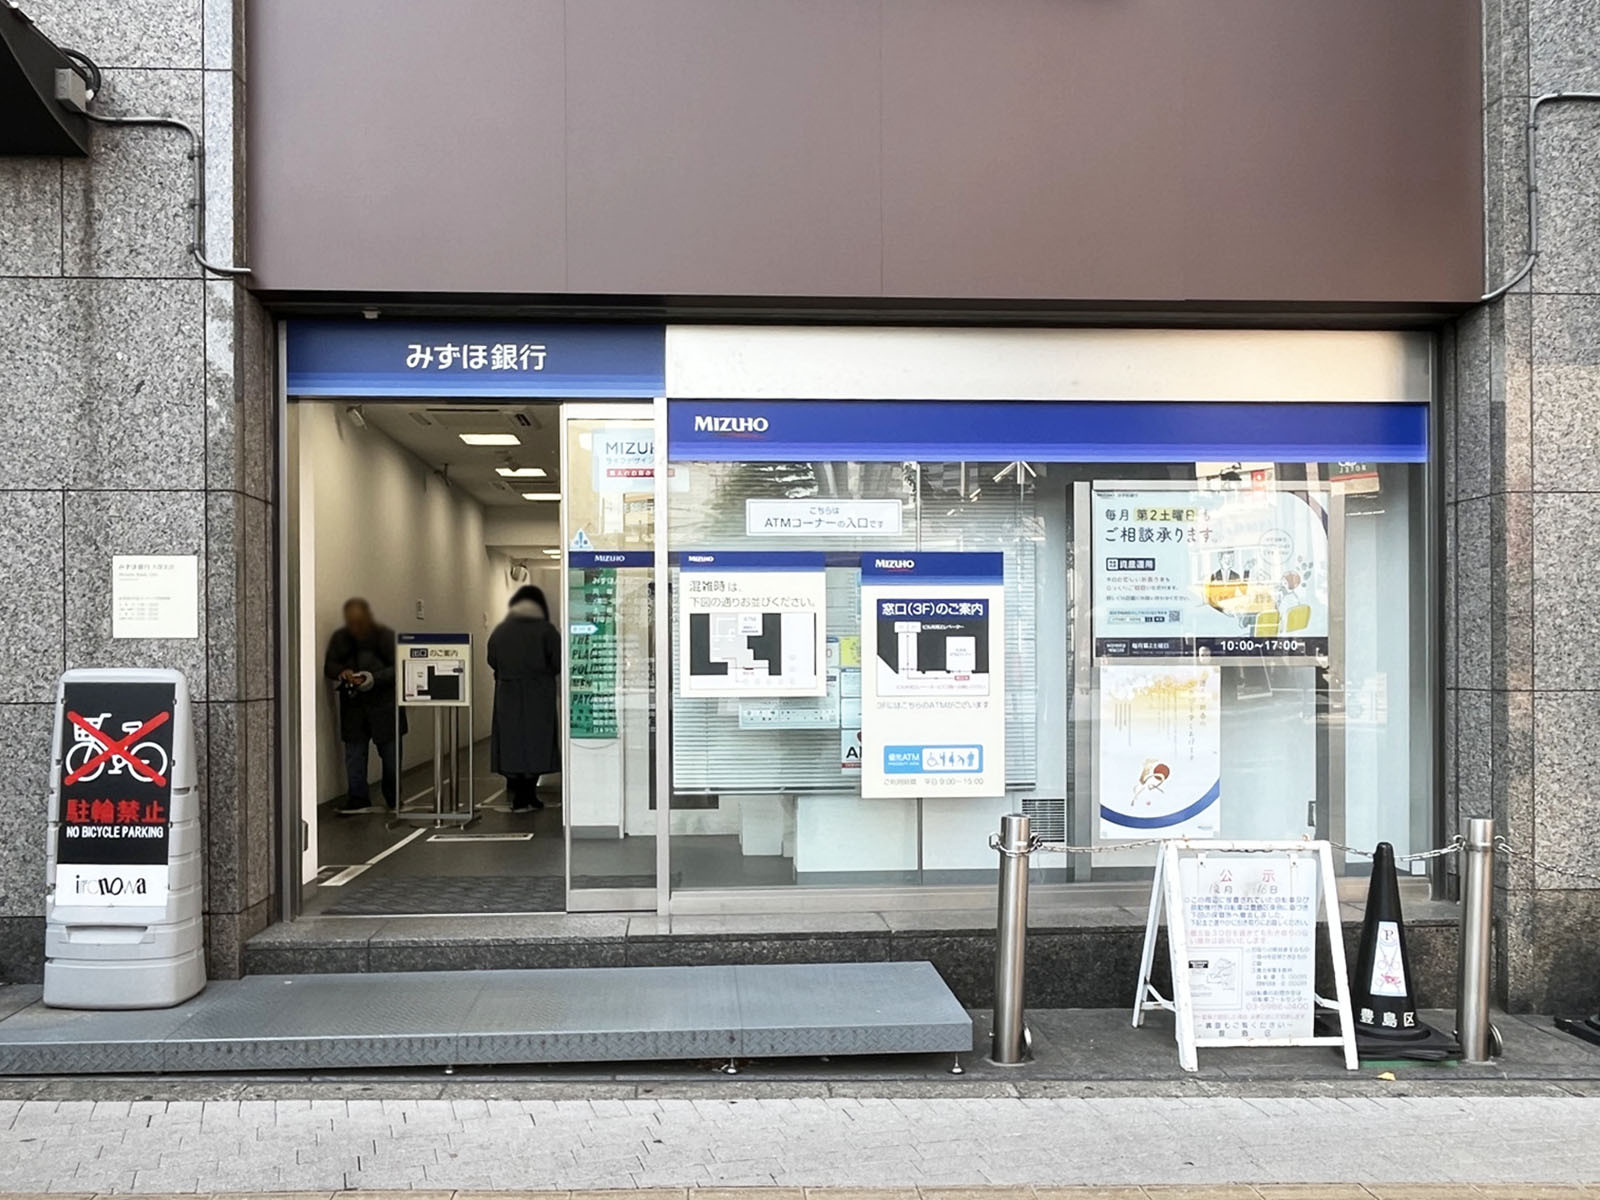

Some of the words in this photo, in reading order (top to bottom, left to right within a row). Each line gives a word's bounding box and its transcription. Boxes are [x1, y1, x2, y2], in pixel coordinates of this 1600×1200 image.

[406, 344, 547, 371] みずほ銀行
[694, 416, 769, 432] MIZUHO
[809, 506, 839, 515] こちらは
[1105, 508, 1129, 522] 毎月
[1136, 508, 1196, 522] 第2土曜日
[764, 517, 884, 528] ATMコーナーの入口です
[875, 559, 915, 569] MIZUHO
[882, 603, 984, 616] 窓口(3F)のご案内
[66, 799, 166, 823] 駐輪禁止
[66, 826, 79, 838] NO
[81, 826, 120, 838] BICYCLE
[122, 826, 164, 838] PARKING
[1384, 930, 1394, 940] P
[1360, 1008, 1416, 1028] 豊島区
